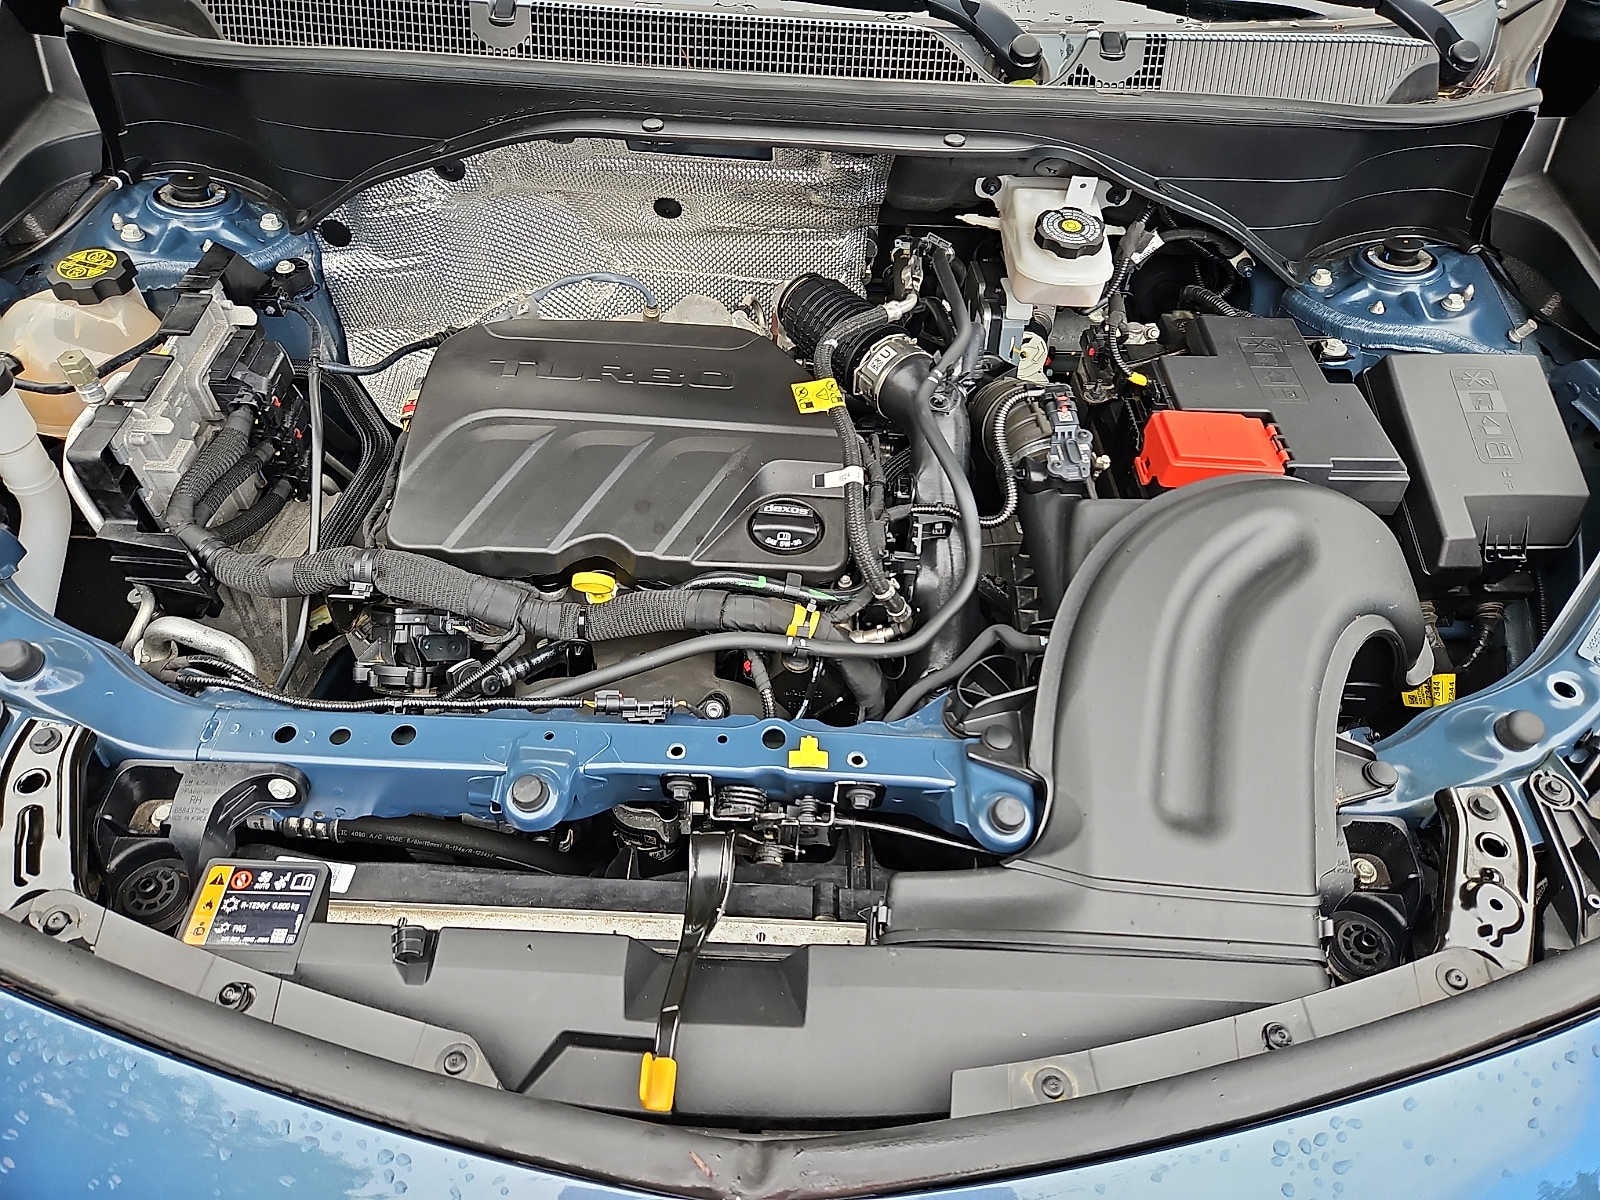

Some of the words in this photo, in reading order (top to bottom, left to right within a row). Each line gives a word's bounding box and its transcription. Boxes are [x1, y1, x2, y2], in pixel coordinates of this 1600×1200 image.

[488, 359, 736, 391] TURBO
[763, 504, 810, 515] dexos
[1432, 681, 1441, 702] 7344
[369, 833, 383, 841] A/C
[291, 902, 301, 912] kg
[232, 924, 247, 934] PAG
